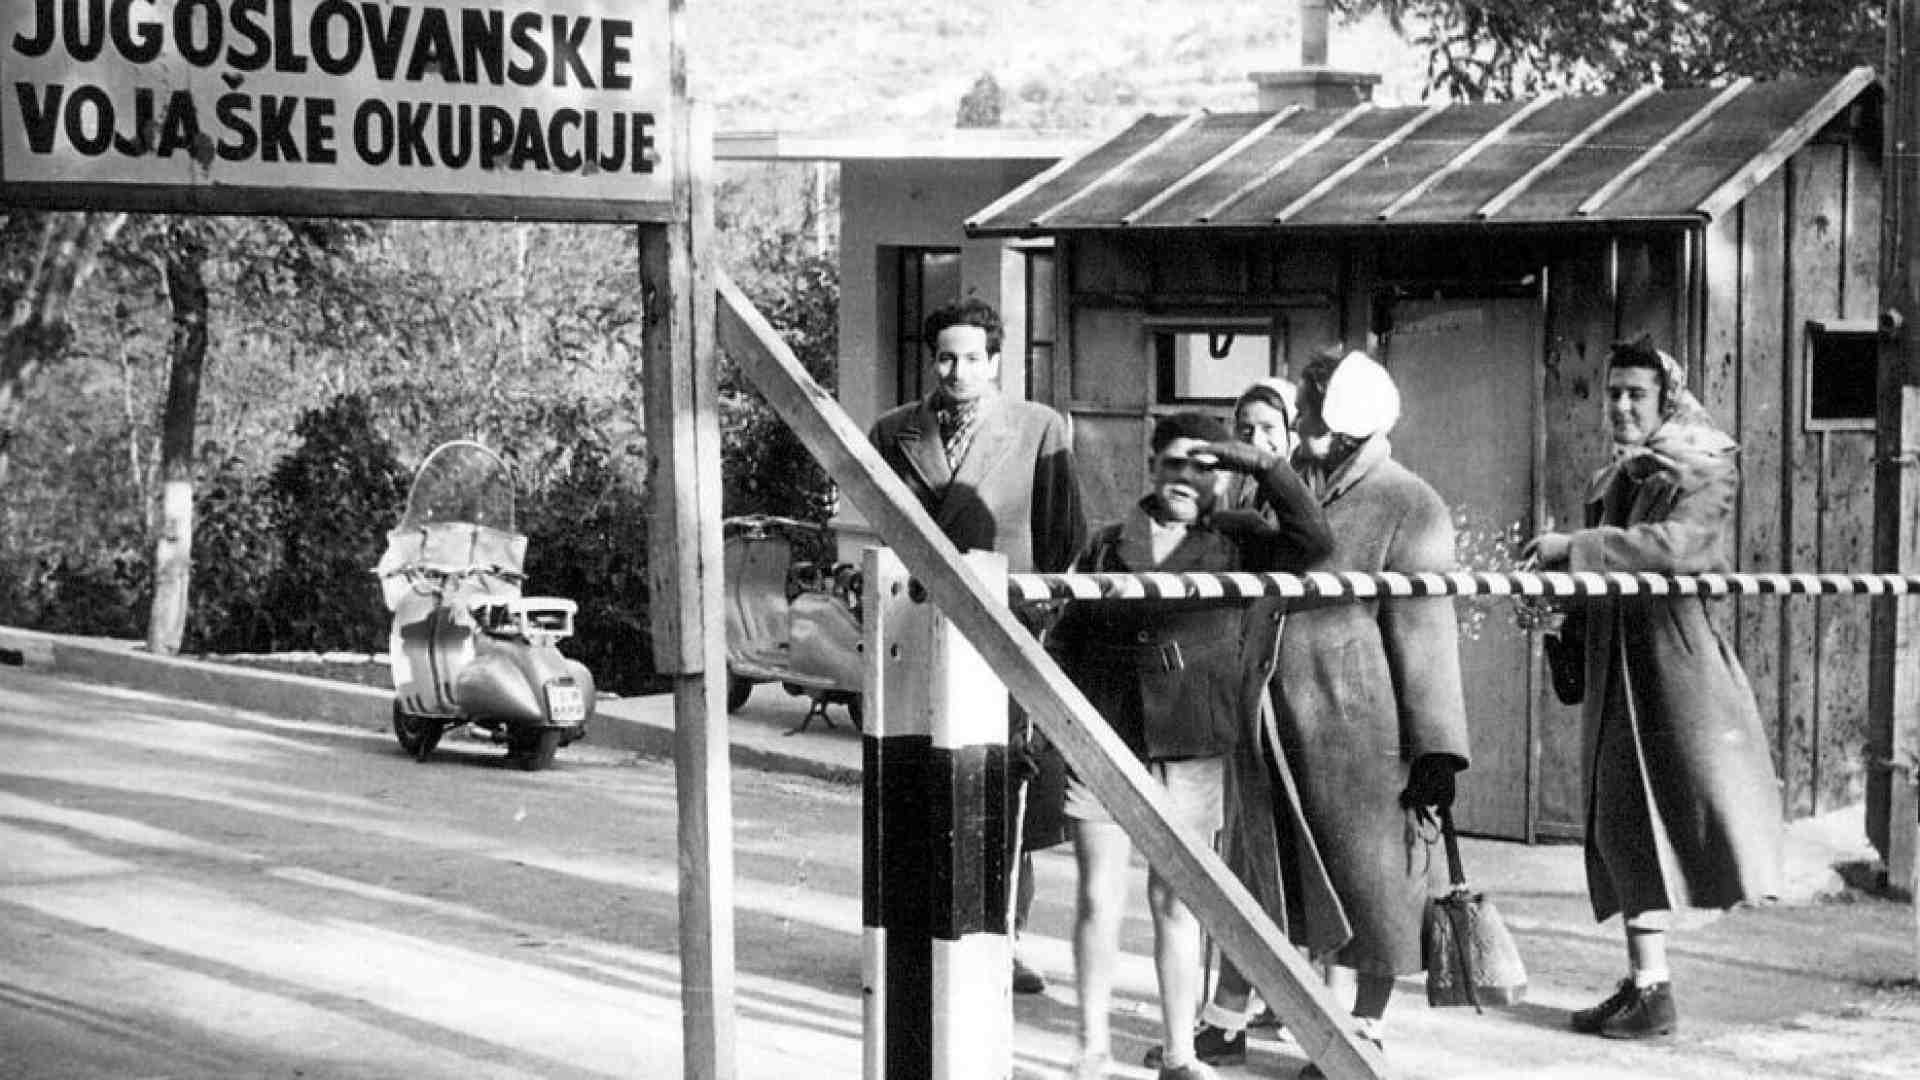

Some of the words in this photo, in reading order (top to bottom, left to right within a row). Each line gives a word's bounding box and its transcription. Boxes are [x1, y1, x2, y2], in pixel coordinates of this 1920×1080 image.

[12, 0, 632, 89] JUGOSLOVANSKE
[15, 72, 337, 164] VOJAŠKE
[353, 98, 655, 174] OKUPACIJE
